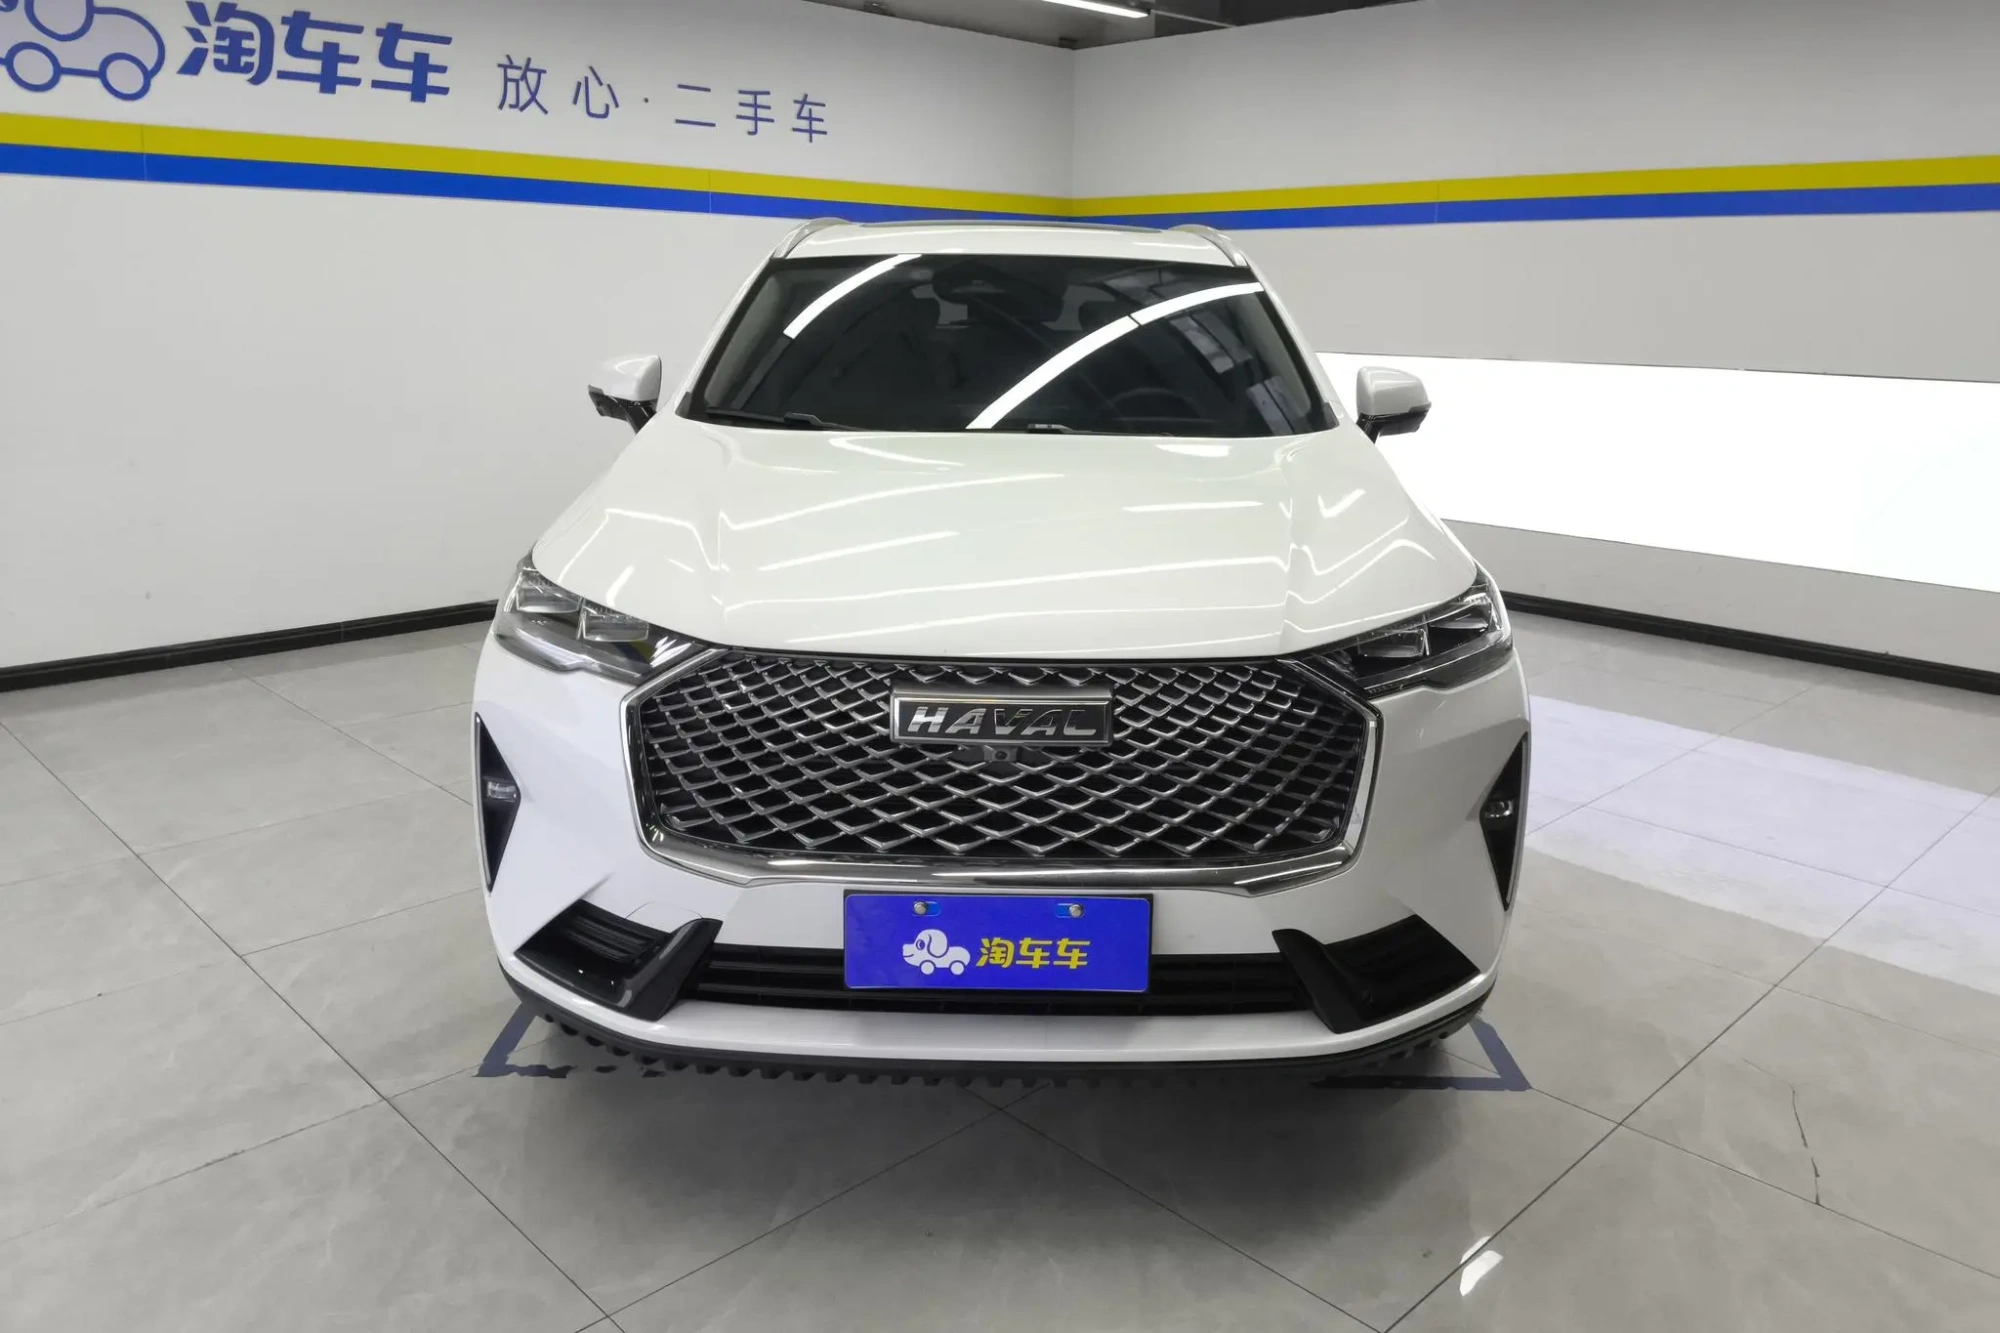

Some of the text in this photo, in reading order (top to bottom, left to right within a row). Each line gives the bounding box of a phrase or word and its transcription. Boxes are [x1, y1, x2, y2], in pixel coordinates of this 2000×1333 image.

[176, 0, 453, 103] 淘车车
[907, 706, 1096, 736] HAVAL
[976, 937, 1091, 969] 淘车车
